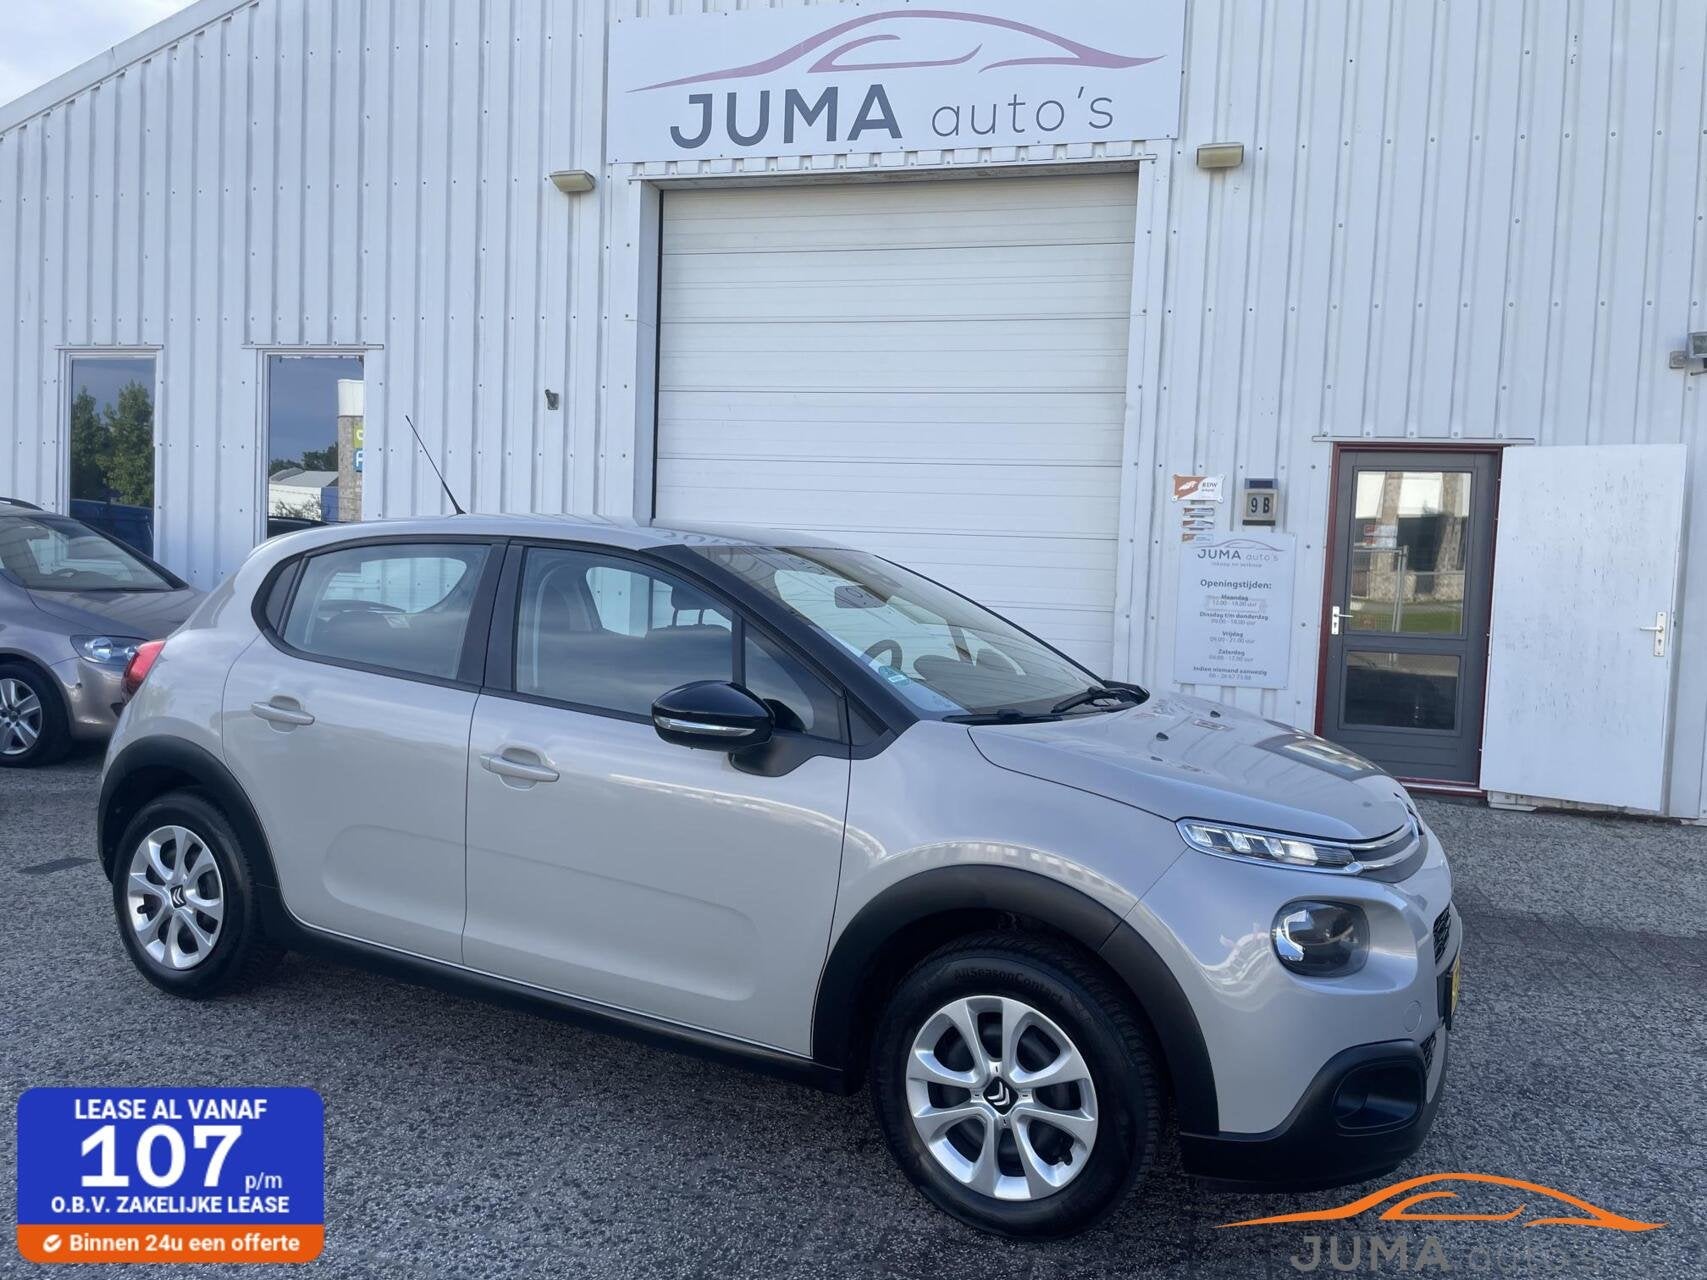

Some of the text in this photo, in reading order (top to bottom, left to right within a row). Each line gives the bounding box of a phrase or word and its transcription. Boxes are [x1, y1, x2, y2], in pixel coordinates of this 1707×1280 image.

[669, 84, 1114, 149] JUMA auto's
[1250, 497, 1270, 514] 9 B
[1197, 548, 1280, 562] JUMA auto's
[1200, 578, 1272, 590] Openingstijden:
[1199, 611, 1224, 619] Dinsdag
[1236, 613, 1269, 621] donderdag
[1222, 630, 1244, 638] Vrijdag
[1218, 648, 1246, 657] Zaterdag
[1212, 666, 1239, 674] niemand
[1239, 668, 1268, 677] aanwezig
